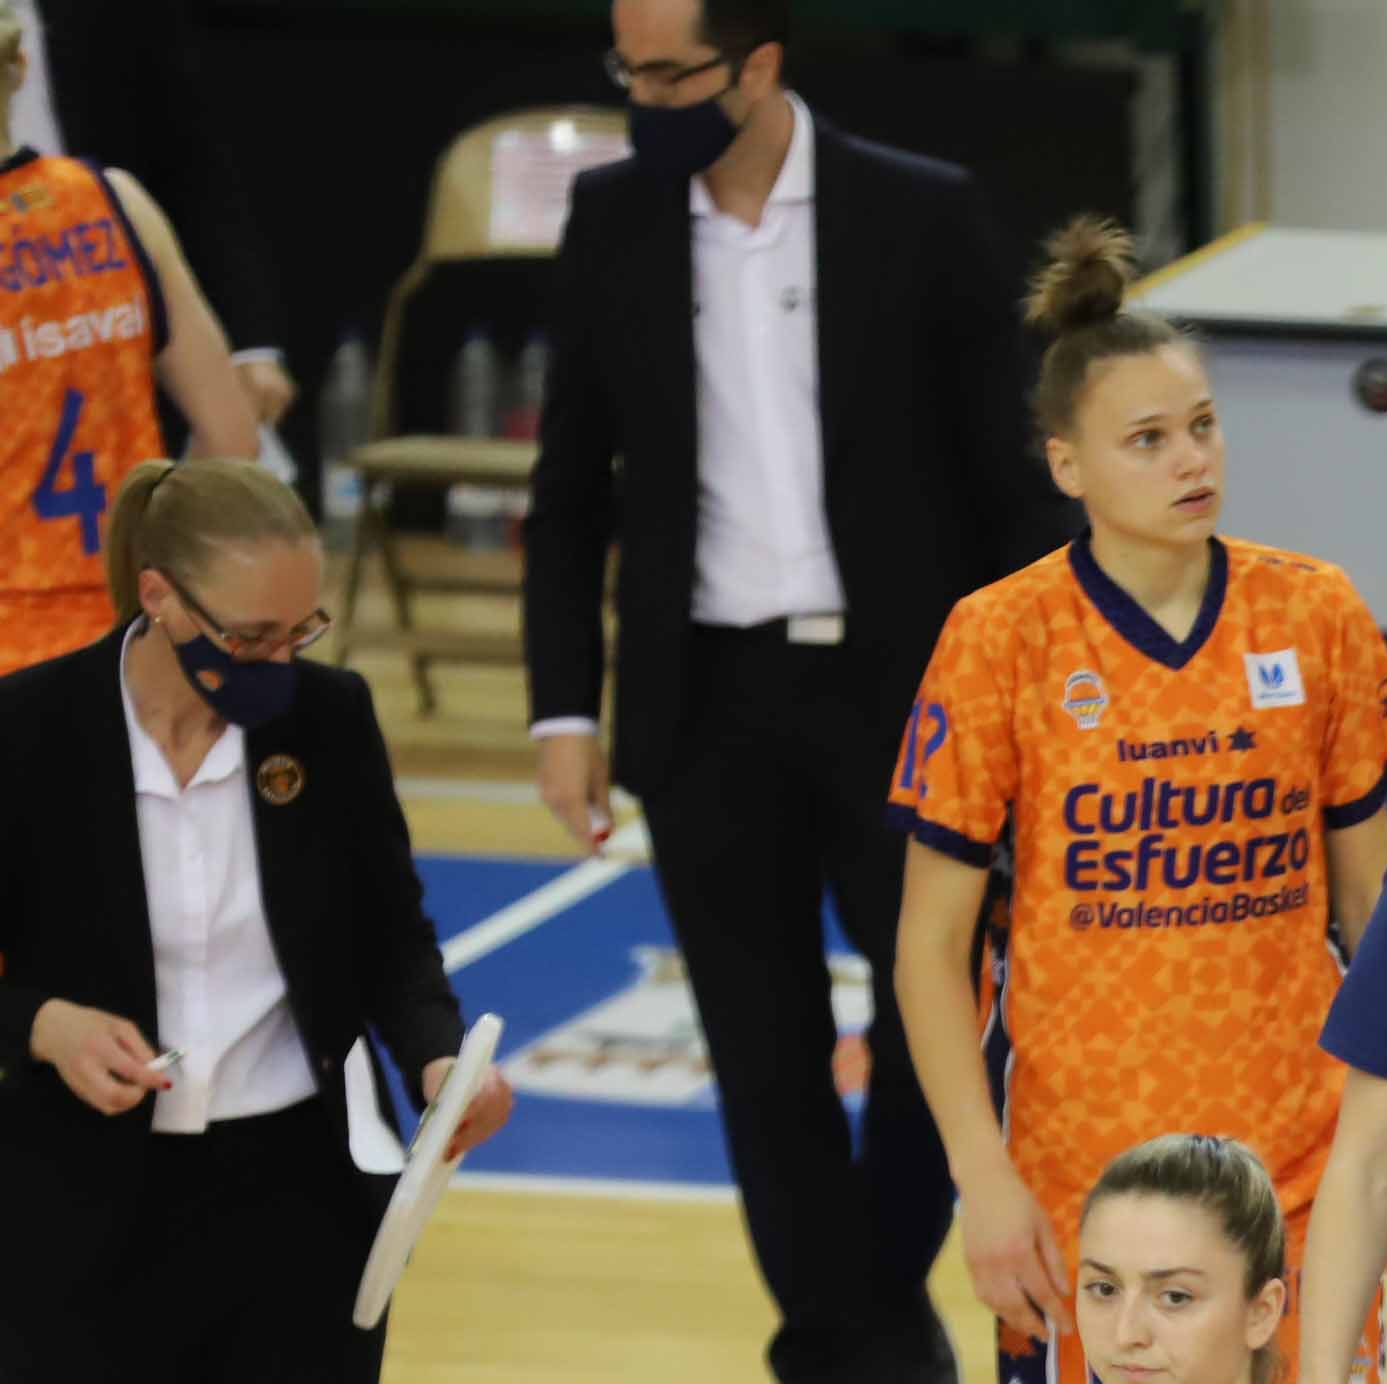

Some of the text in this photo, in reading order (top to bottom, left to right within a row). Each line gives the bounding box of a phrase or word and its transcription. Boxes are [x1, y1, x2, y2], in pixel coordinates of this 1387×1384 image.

[33, 388, 106, 555] 4
[1118, 729, 1220, 762] luanvi
[1063, 777, 1276, 835] Cultura
[1063, 828, 1310, 892] Esfuerzo
